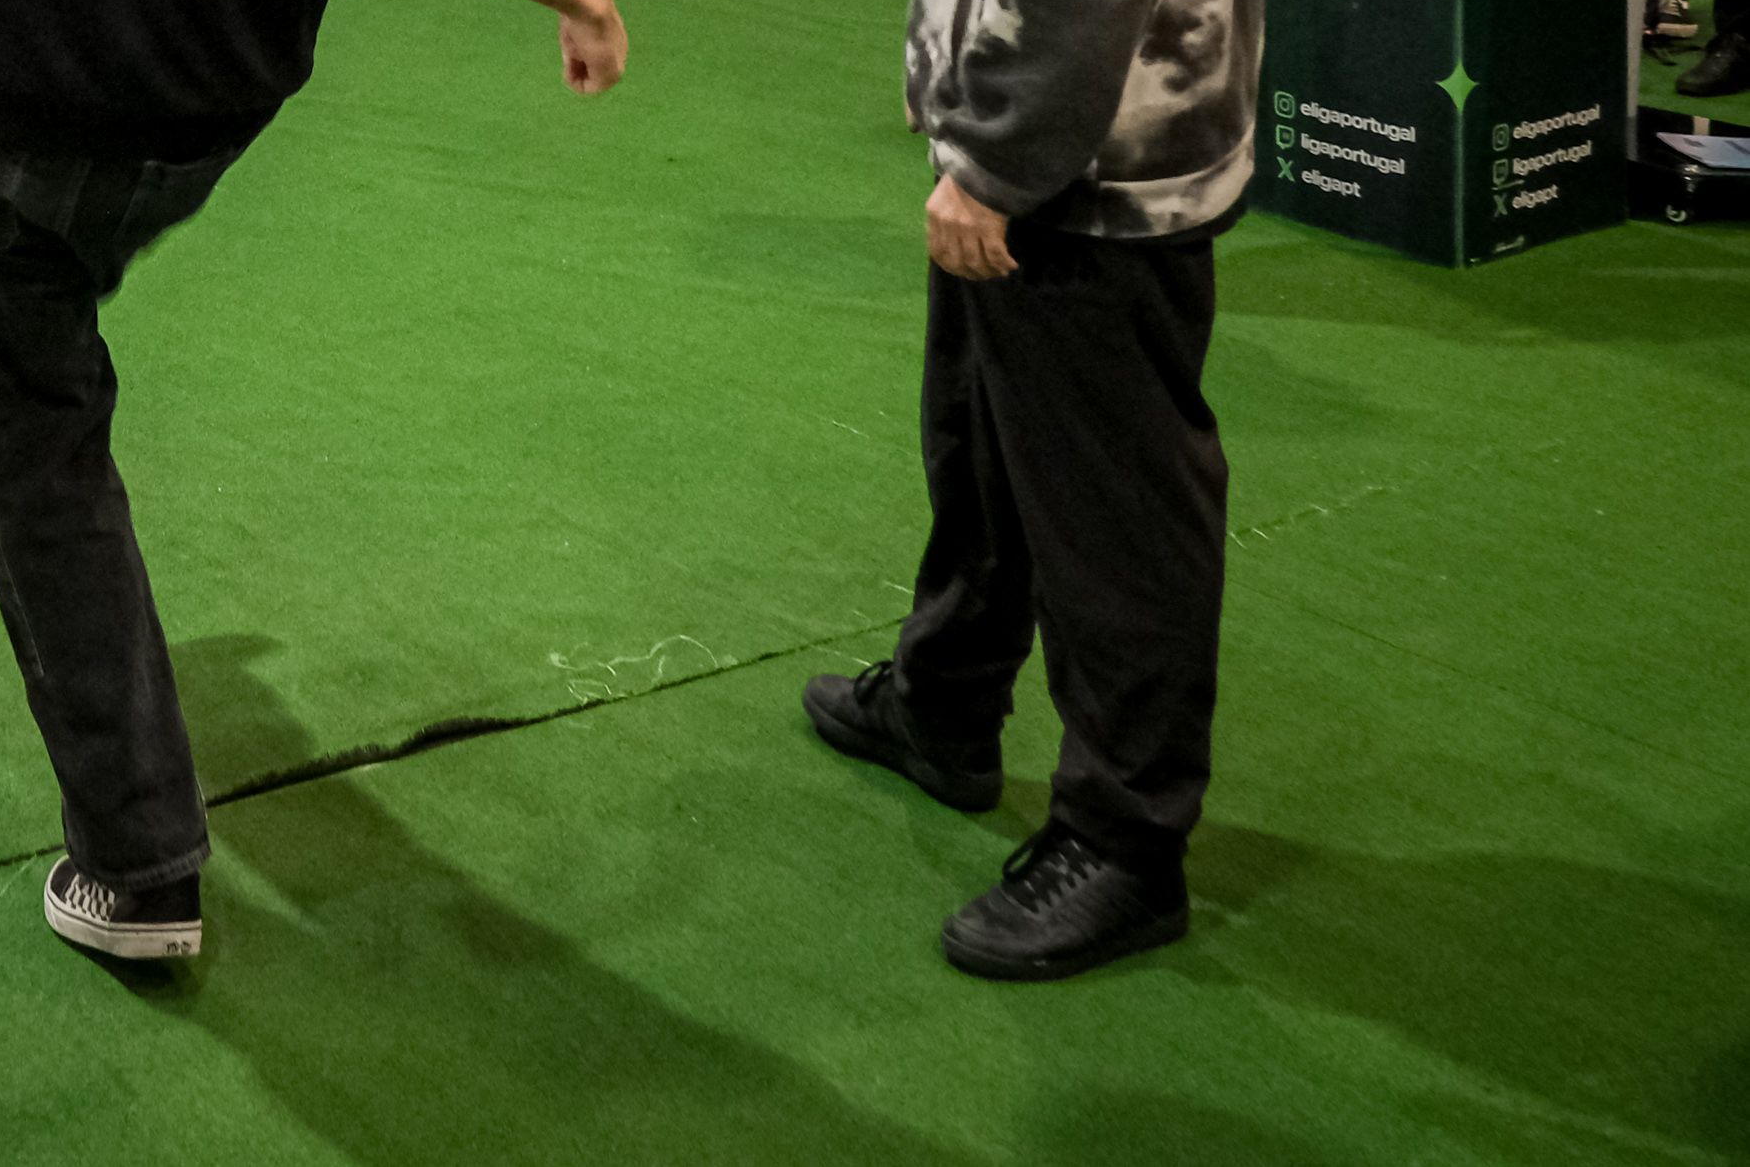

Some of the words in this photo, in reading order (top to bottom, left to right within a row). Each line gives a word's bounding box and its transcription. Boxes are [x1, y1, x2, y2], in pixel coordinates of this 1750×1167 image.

[1300, 101, 1416, 142] eligaportugal
[1301, 133, 1405, 174] ligaportugal
[1301, 169, 1362, 198] eligapt
